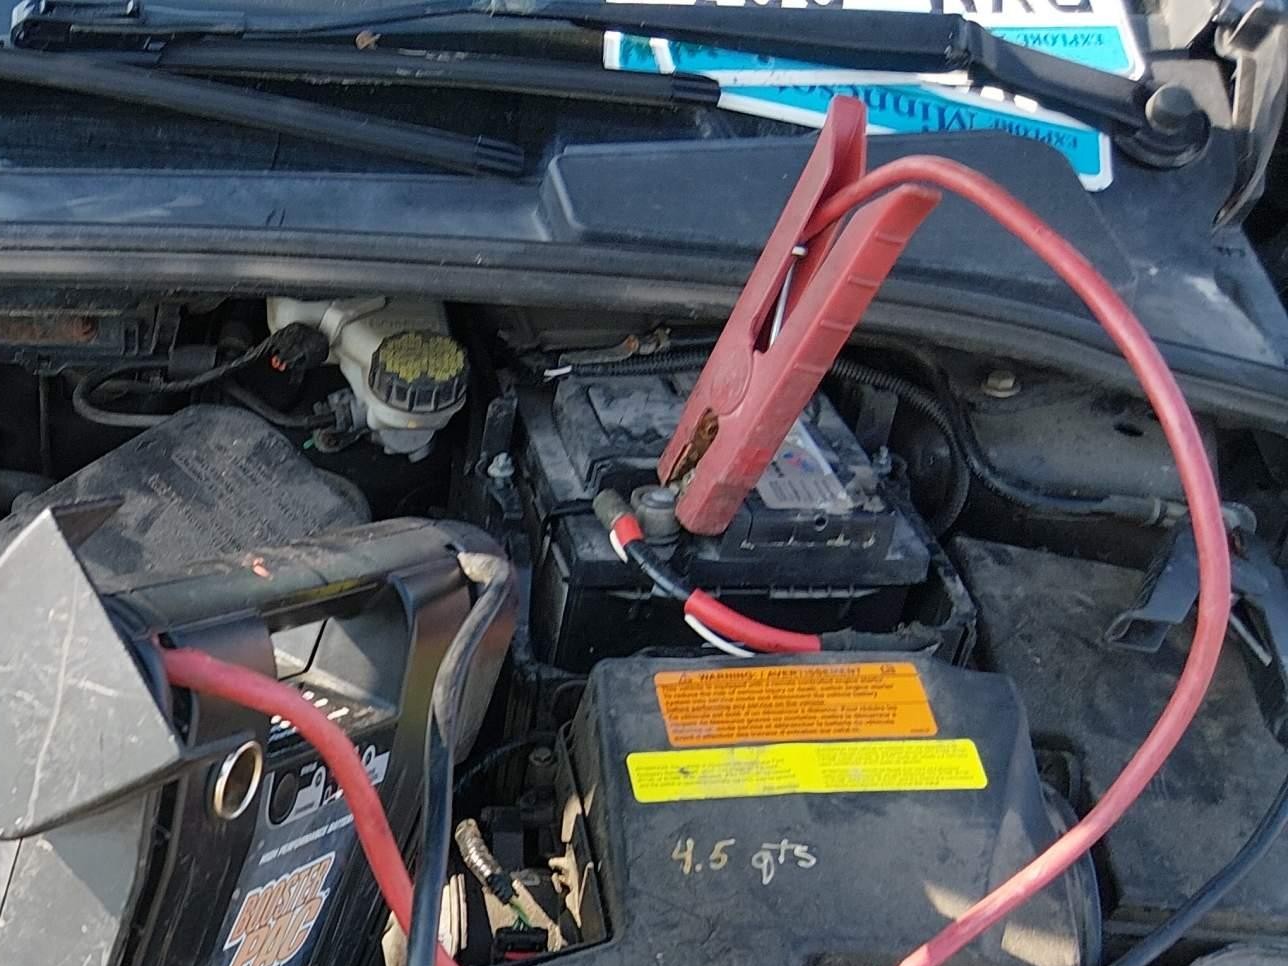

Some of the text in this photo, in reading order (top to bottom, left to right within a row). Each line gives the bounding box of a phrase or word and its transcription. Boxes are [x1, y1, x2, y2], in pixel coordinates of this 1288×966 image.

[671, 836, 817, 886] 4.5 qts
[226, 854, 334, 948] BOOSTER
